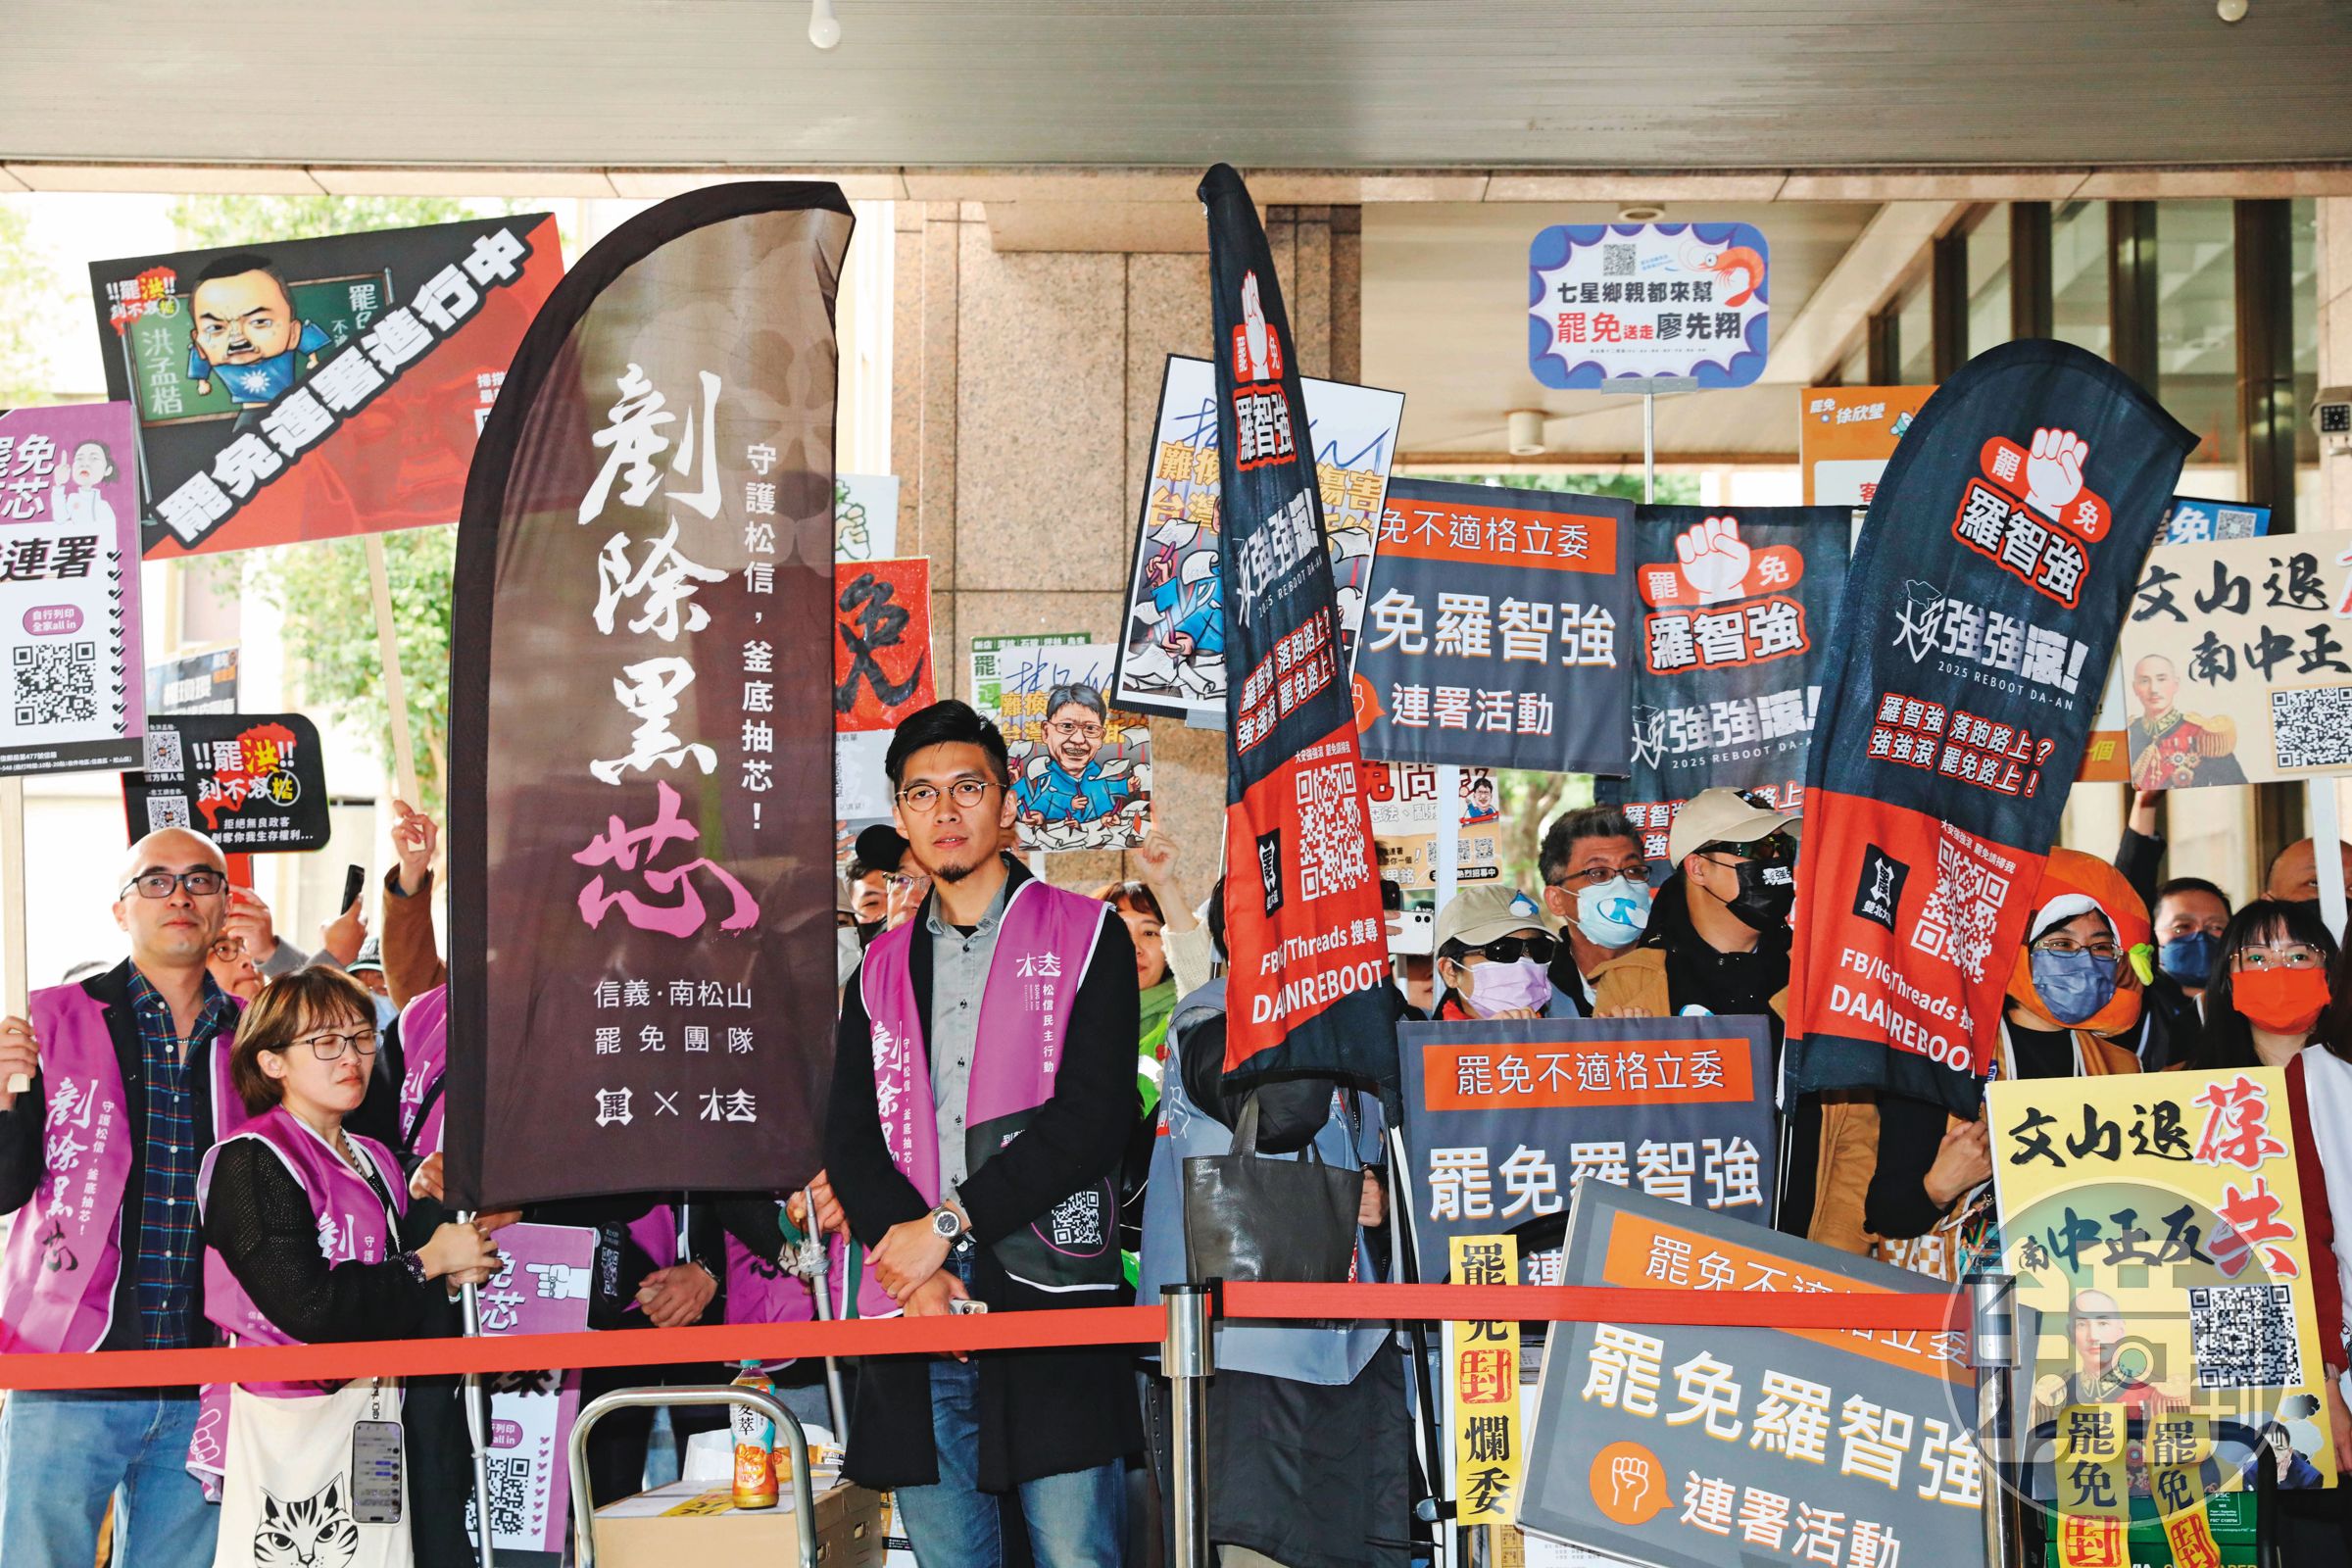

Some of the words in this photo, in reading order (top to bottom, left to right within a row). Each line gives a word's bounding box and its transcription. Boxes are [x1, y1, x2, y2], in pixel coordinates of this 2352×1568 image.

[1557, 280, 1713, 303] 七星鄉親都來幫
[1557, 312, 1741, 343] 罷免送走廖先翔
[142, 327, 183, 416] 洪孟楷
[156, 227, 525, 542] 罷免連署進行中
[0, 478, 49, 519] 芯
[1992, 445, 2022, 482] 罷
[2073, 500, 2099, 535] 免
[0, 535, 100, 583] 連署
[1959, 486, 2084, 601] 羅智強
[1647, 571, 1678, 600] 罷
[1757, 555, 1790, 586] 免
[2132, 551, 2352, 623] 文山退
[741, 443, 777, 830] 守護松信，釜底抽芯！
[1650, 601, 1805, 670] 羅智強
[1391, 683, 1553, 736] 連署活動
[1938, 661, 1969, 678] 2025
[1974, 672, 2024, 696] REBOOT
[2031, 690, 2075, 711] DA-AN
[1672, 758, 1706, 768] 2025
[1712, 746, 1771, 762] REBOOT
[1880, 695, 1946, 735] 羅智強
[1950, 712, 2055, 764] 落跑路上？
[1870, 729, 1936, 766] 強強滾
[1938, 747, 2040, 799] 罷免路上！
[594, 980, 753, 1009] 信義·南松山
[1252, 959, 1383, 1025] DANREBOOT
[595, 1025, 755, 1055] 罷免團隊
[1042, 983, 1054, 1073] 松信民主行動
[1829, 984, 1976, 1080] DAAREBOO
[1456, 1049, 1725, 1097] 罷免不適格立委
[477, 1291, 526, 1331] 芯
[1581, 1322, 1984, 1509] 罷免羅智強
[1679, 1470, 1901, 1568] 連署活動
